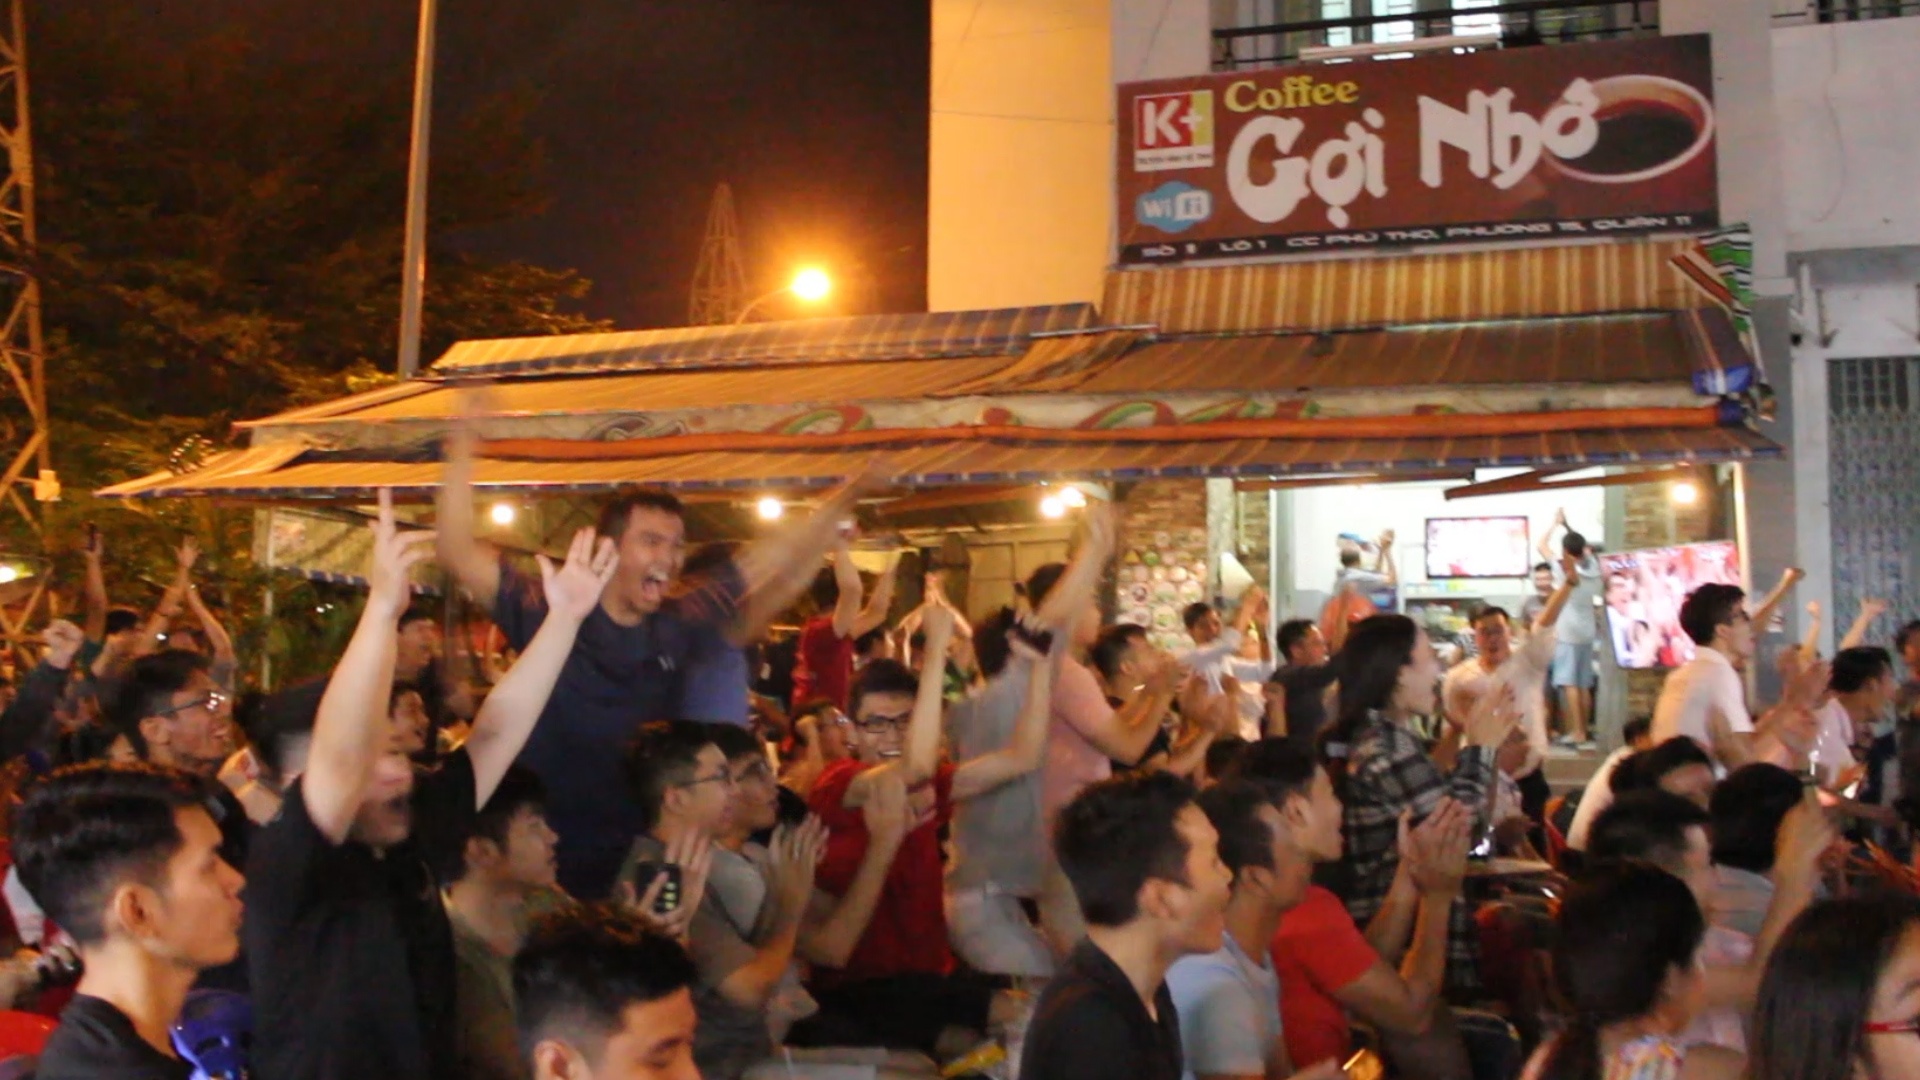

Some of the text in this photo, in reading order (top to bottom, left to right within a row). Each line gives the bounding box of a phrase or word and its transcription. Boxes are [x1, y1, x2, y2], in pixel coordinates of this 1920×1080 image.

[1224, 75, 1359, 112] Coffee
[1143, 98, 1203, 146] K+
[1227, 107, 1388, 228] Gợi
